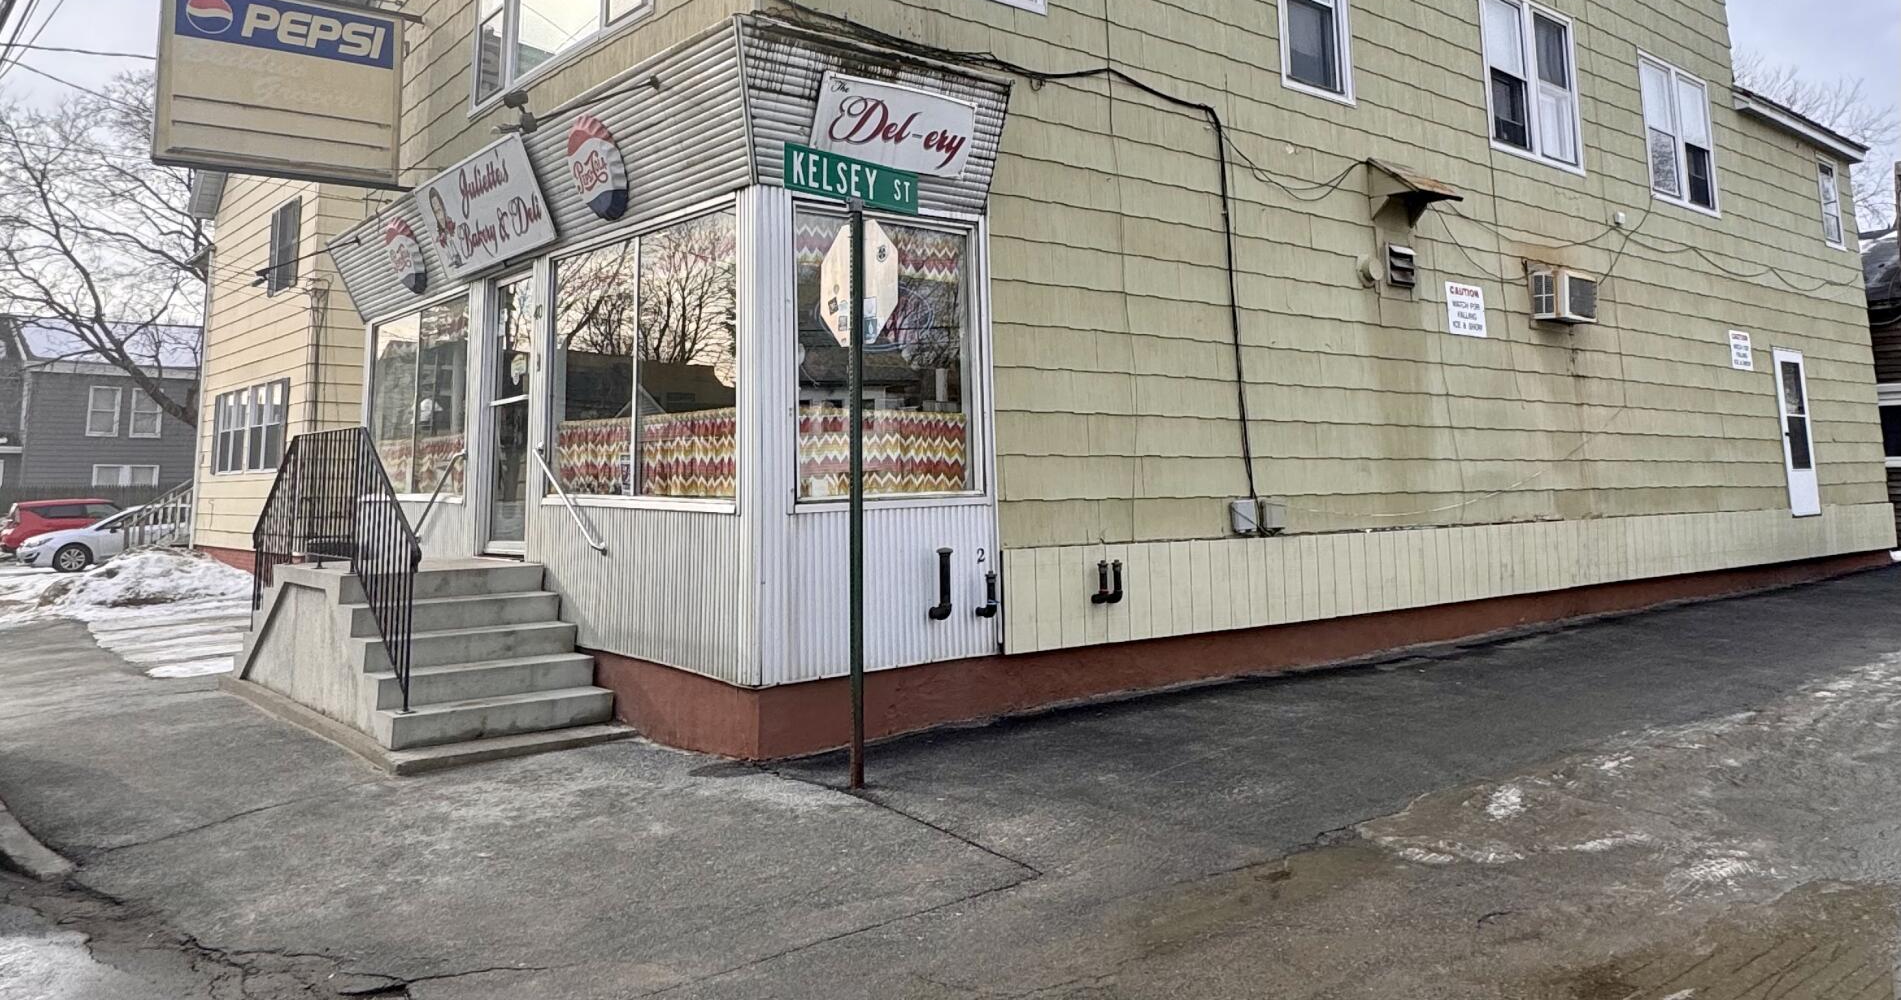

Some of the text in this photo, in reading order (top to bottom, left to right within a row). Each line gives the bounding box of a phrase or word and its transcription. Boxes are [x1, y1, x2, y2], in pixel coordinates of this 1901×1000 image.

[240, 3, 387, 60] PEPSI
[830, 79, 849, 93] The
[828, 95, 967, 170] Del-ery
[792, 150, 911, 203] KELSEY ST
[457, 218, 498, 259] Bakery
[496, 207, 511, 243] &
[508, 192, 542, 237] Deli
[1450, 286, 1479, 298] CAUTION
[534, 304, 542, 320] 40
[976, 547, 986, 565] 2
